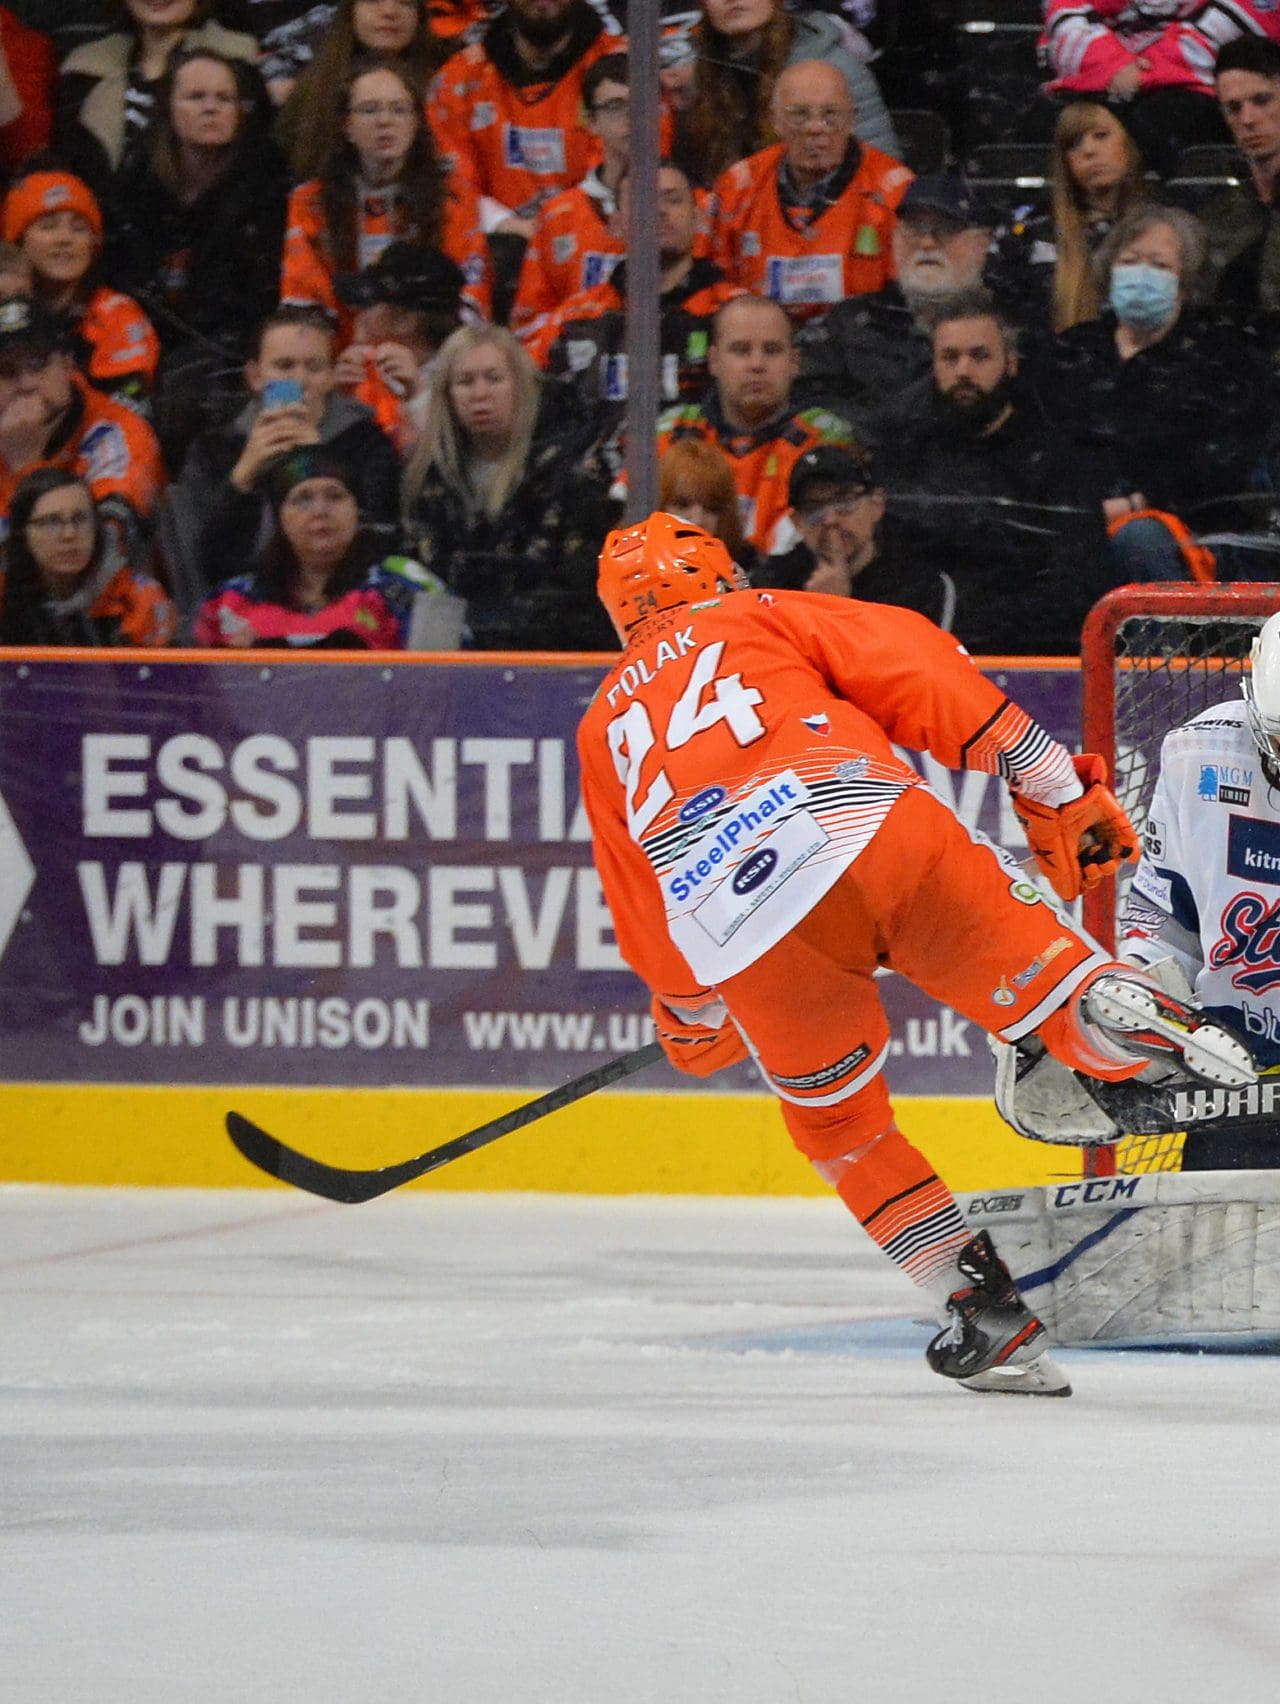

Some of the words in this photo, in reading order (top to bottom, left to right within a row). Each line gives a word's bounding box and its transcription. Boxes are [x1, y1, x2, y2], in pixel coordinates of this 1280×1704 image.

[606, 640, 767, 842] 24
[82, 733, 593, 842] ESSENTI
[1219, 766, 1253, 786] MGM
[670, 781, 797, 902] SteelPhalt
[735, 854, 773, 889] RSH
[79, 995, 206, 1047] JOIN
[222, 995, 430, 1049] UNISON
[1054, 1176, 1141, 1209] CCM
